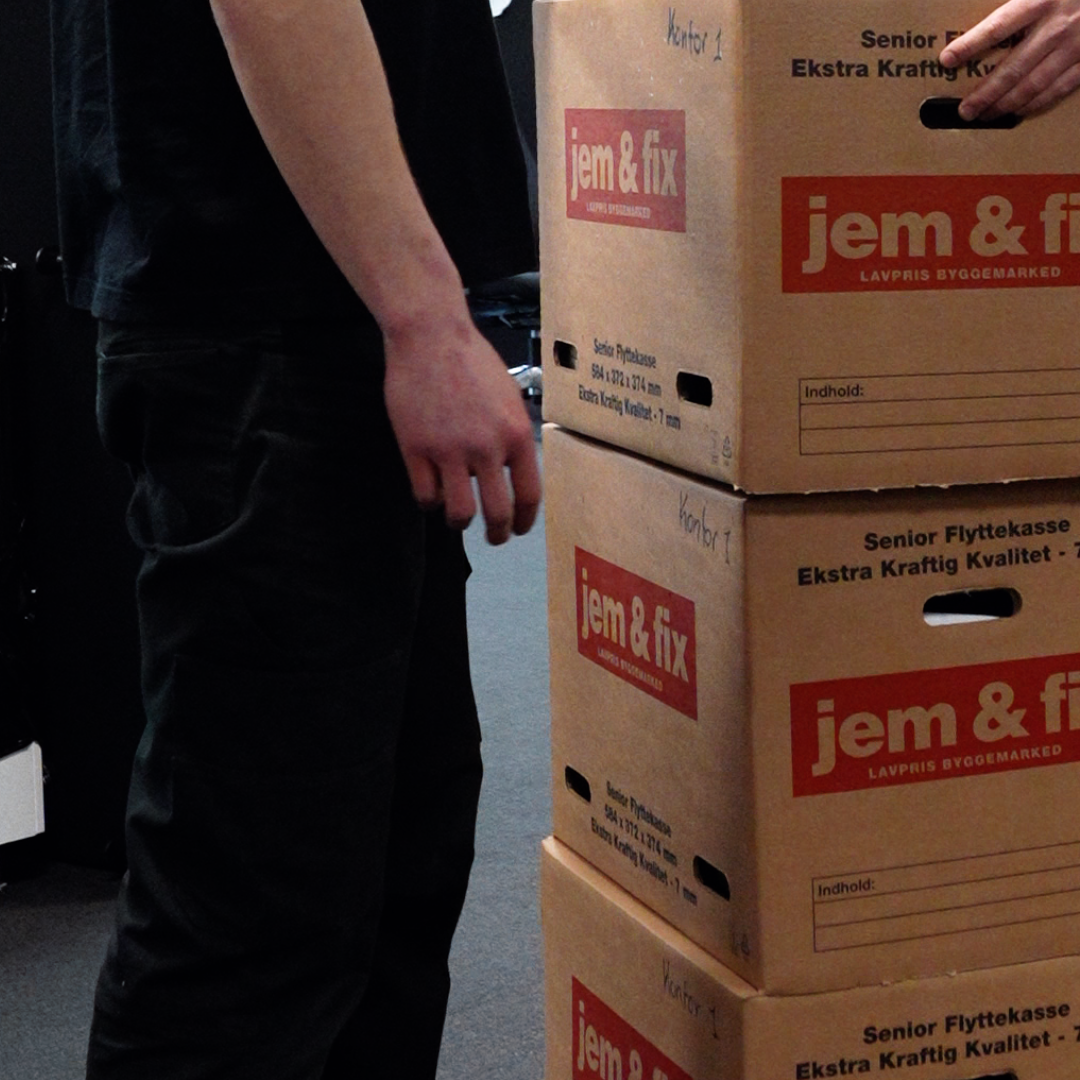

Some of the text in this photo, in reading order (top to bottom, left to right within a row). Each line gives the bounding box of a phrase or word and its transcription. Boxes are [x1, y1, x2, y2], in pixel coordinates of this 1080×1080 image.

[667, 7, 708, 55] Kontor
[860, 29, 937, 49] Senior
[791, 58, 869, 78] Ekstra
[877, 58, 959, 81] Kraftig
[570, 127, 678, 202] jem & fix
[802, 195, 953, 275] jem
[969, 195, 1029, 258] &
[859, 266, 1062, 283] LAVPRIS BYGGEMARKED
[593, 338, 657, 368] Senior Flyttekasse
[578, 384, 599, 404] Ekstra
[600, 390, 623, 416] Kraftig
[625, 398, 653, 421] Kvalitet
[804, 384, 864, 399] Indhold:
[679, 490, 718, 552] Kontor
[864, 518, 1071, 552] Senior Flyttekasse
[797, 565, 873, 586] Ekstra
[881, 554, 959, 579] Kraftig
[966, 547, 1052, 571] Kvalitet
[581, 567, 690, 684] jem & fix
[811, 698, 957, 778] jem
[972, 681, 1030, 743] &
[868, 744, 1063, 780] LAVPRIS BYGGEMARKED
[817, 879, 876, 897] Indhold:
[863, 1001, 1071, 1045] Senior Flyttekasse
[795, 1058, 871, 1080] Ekstra
[879, 1045, 958, 1068] Kraftig
[965, 1030, 1051, 1059] Kvalitet
